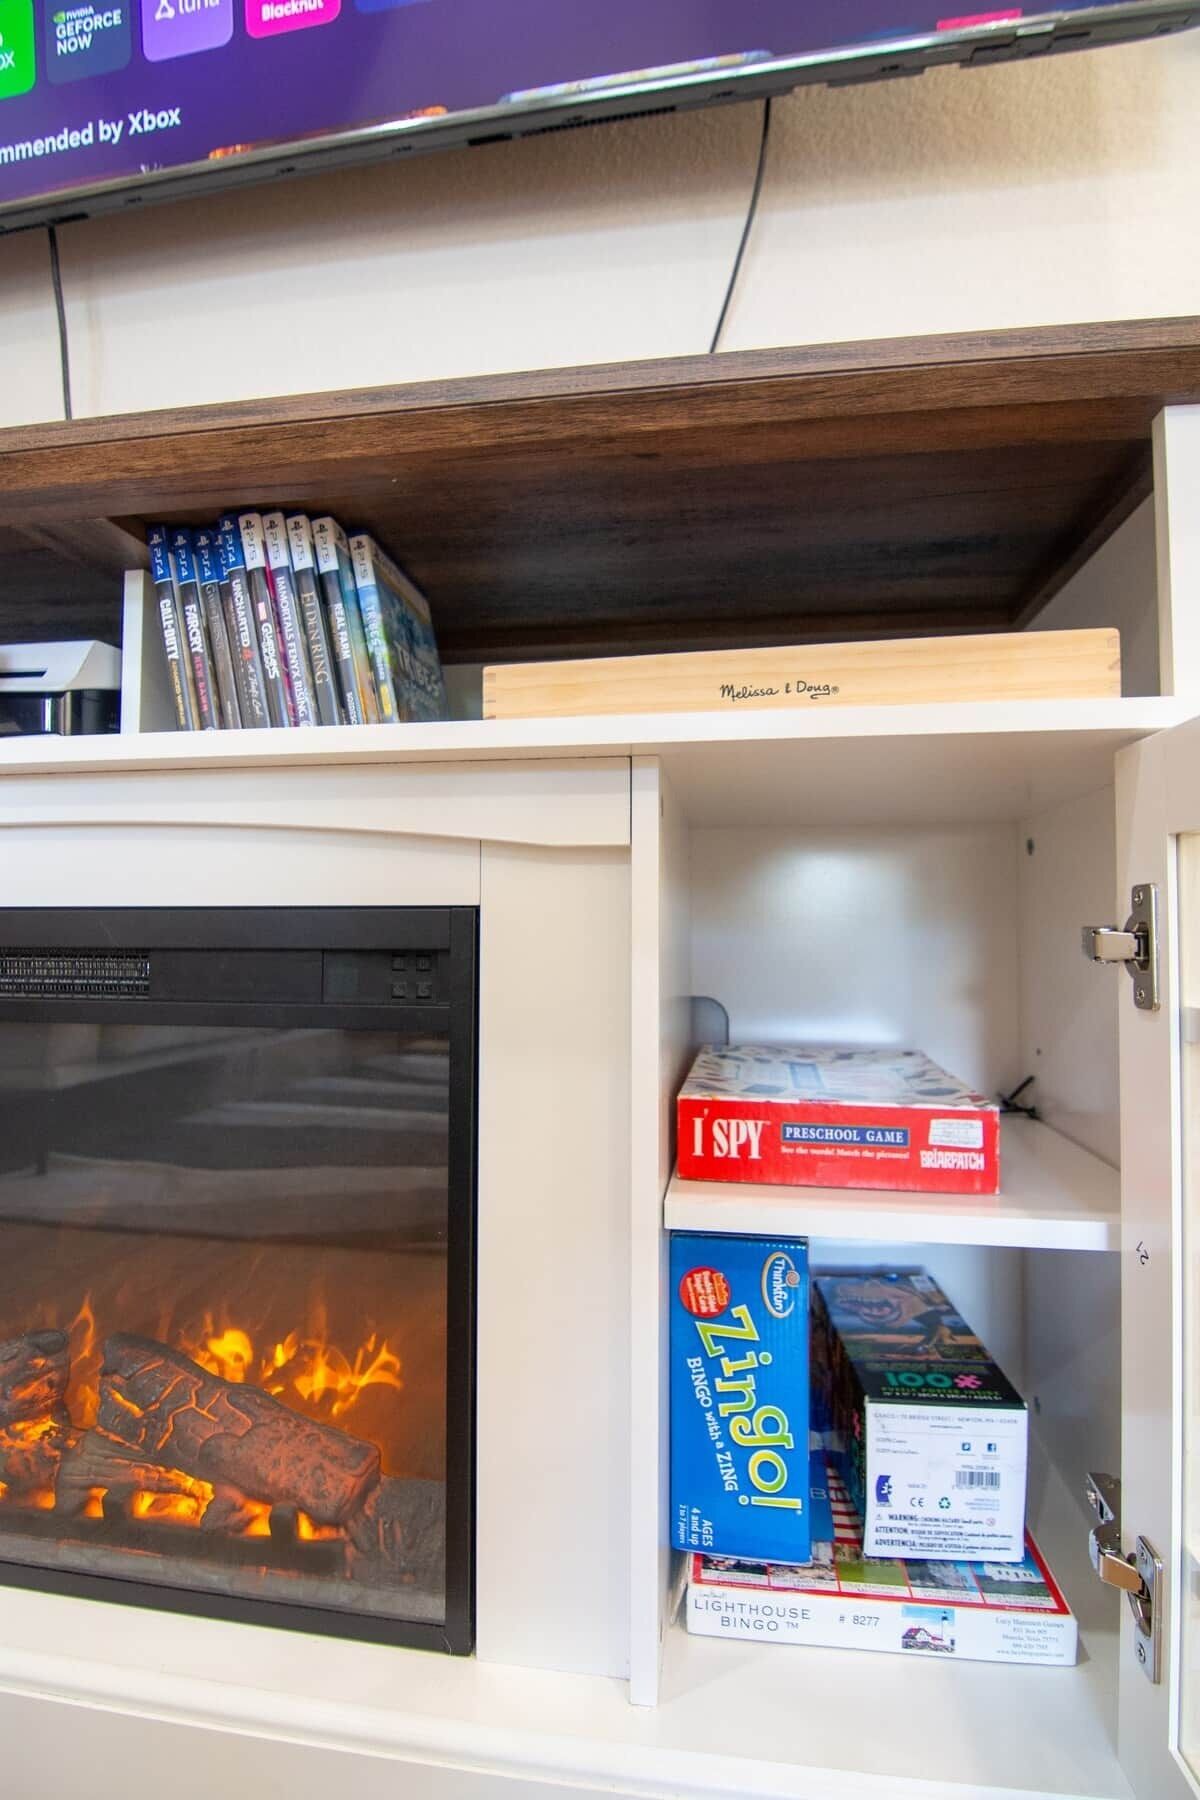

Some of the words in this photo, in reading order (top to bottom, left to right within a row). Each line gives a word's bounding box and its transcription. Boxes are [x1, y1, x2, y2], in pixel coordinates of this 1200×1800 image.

[56, 8, 122, 40] GEFORCE
[261, 0, 324, 22] Blacknut
[57, 32, 92, 56] NOW
[98, 119, 123, 144] by
[128, 107, 181, 136] Xbox
[226, 534, 236, 565] PS4
[231, 579, 250, 647] UNCHARTED
[275, 575, 295, 641] IMMORTALS
[287, 642, 301, 682] FENYX
[312, 644, 329, 684] RING
[720, 684, 779, 702] Melissa
[712, 1118, 762, 1159] SPY
[784, 1126, 860, 1142] PRESCHOOL
[866, 1129, 904, 1144] GAME
[920, 1148, 984, 1170] BRIARPATCH
[686, 1356, 712, 1408] BINGO
[884, 1371, 952, 1387] 100
[695, 1303, 802, 1509] Zingo!
[705, 1411, 724, 1441] with
[715, 1441, 724, 1449] a
[716, 1451, 739, 1492] ZING
[691, 1515, 702, 1532] and
[702, 1519, 713, 1547] AGES
[688, 1533, 699, 1545] up
[694, 1599, 812, 1620] LIGHTHOUSE
[853, 1615, 880, 1627] 8277
[721, 1616, 778, 1631] BINGO
